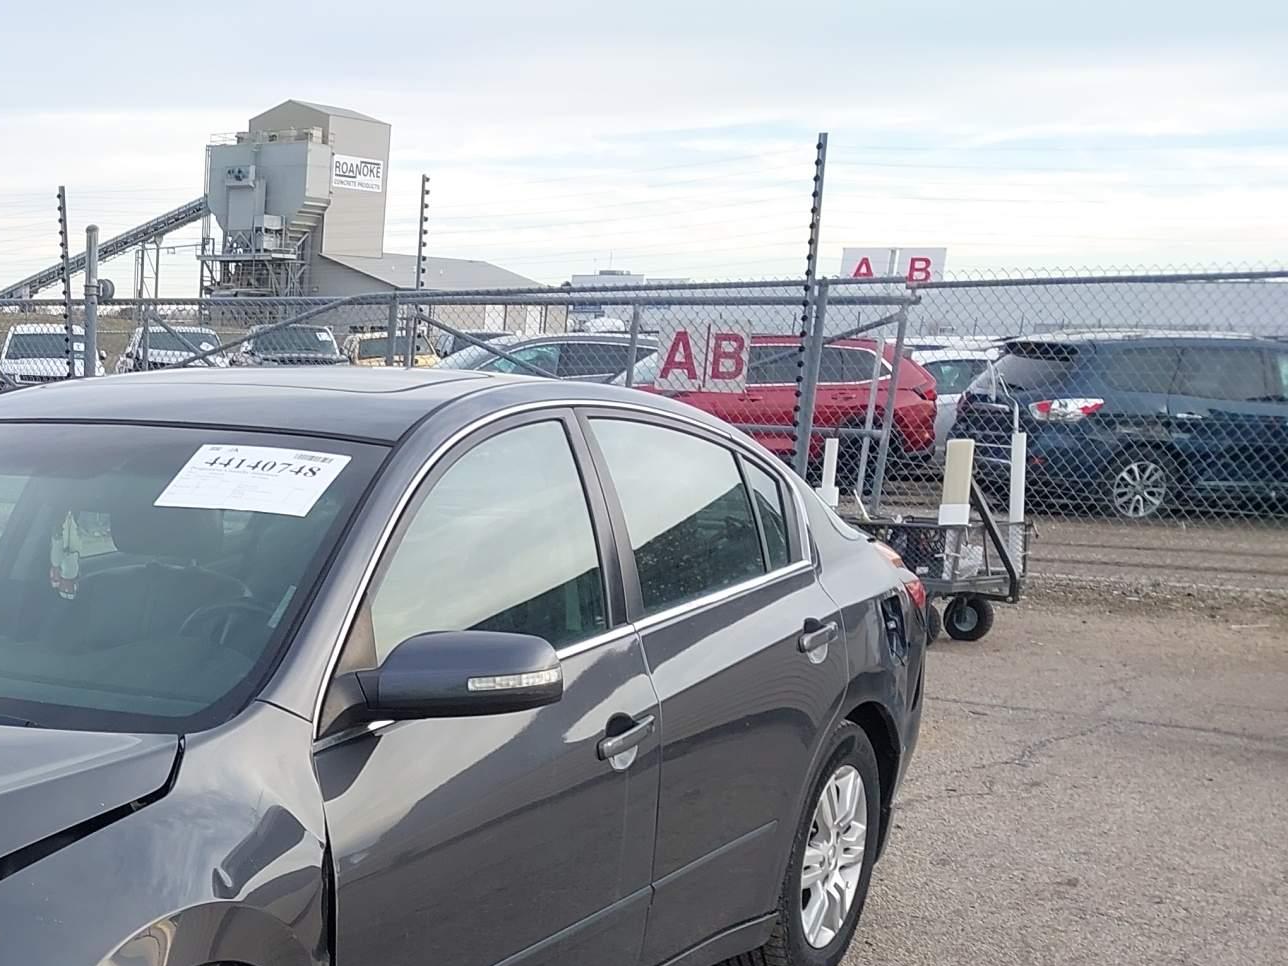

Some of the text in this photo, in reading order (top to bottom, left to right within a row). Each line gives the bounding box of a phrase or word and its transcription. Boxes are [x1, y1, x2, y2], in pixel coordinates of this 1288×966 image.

[334, 160, 381, 178] ROANOKE
[852, 256, 932, 282] A B
[659, 330, 745, 380] A B
[204, 455, 322, 478] 44140748
